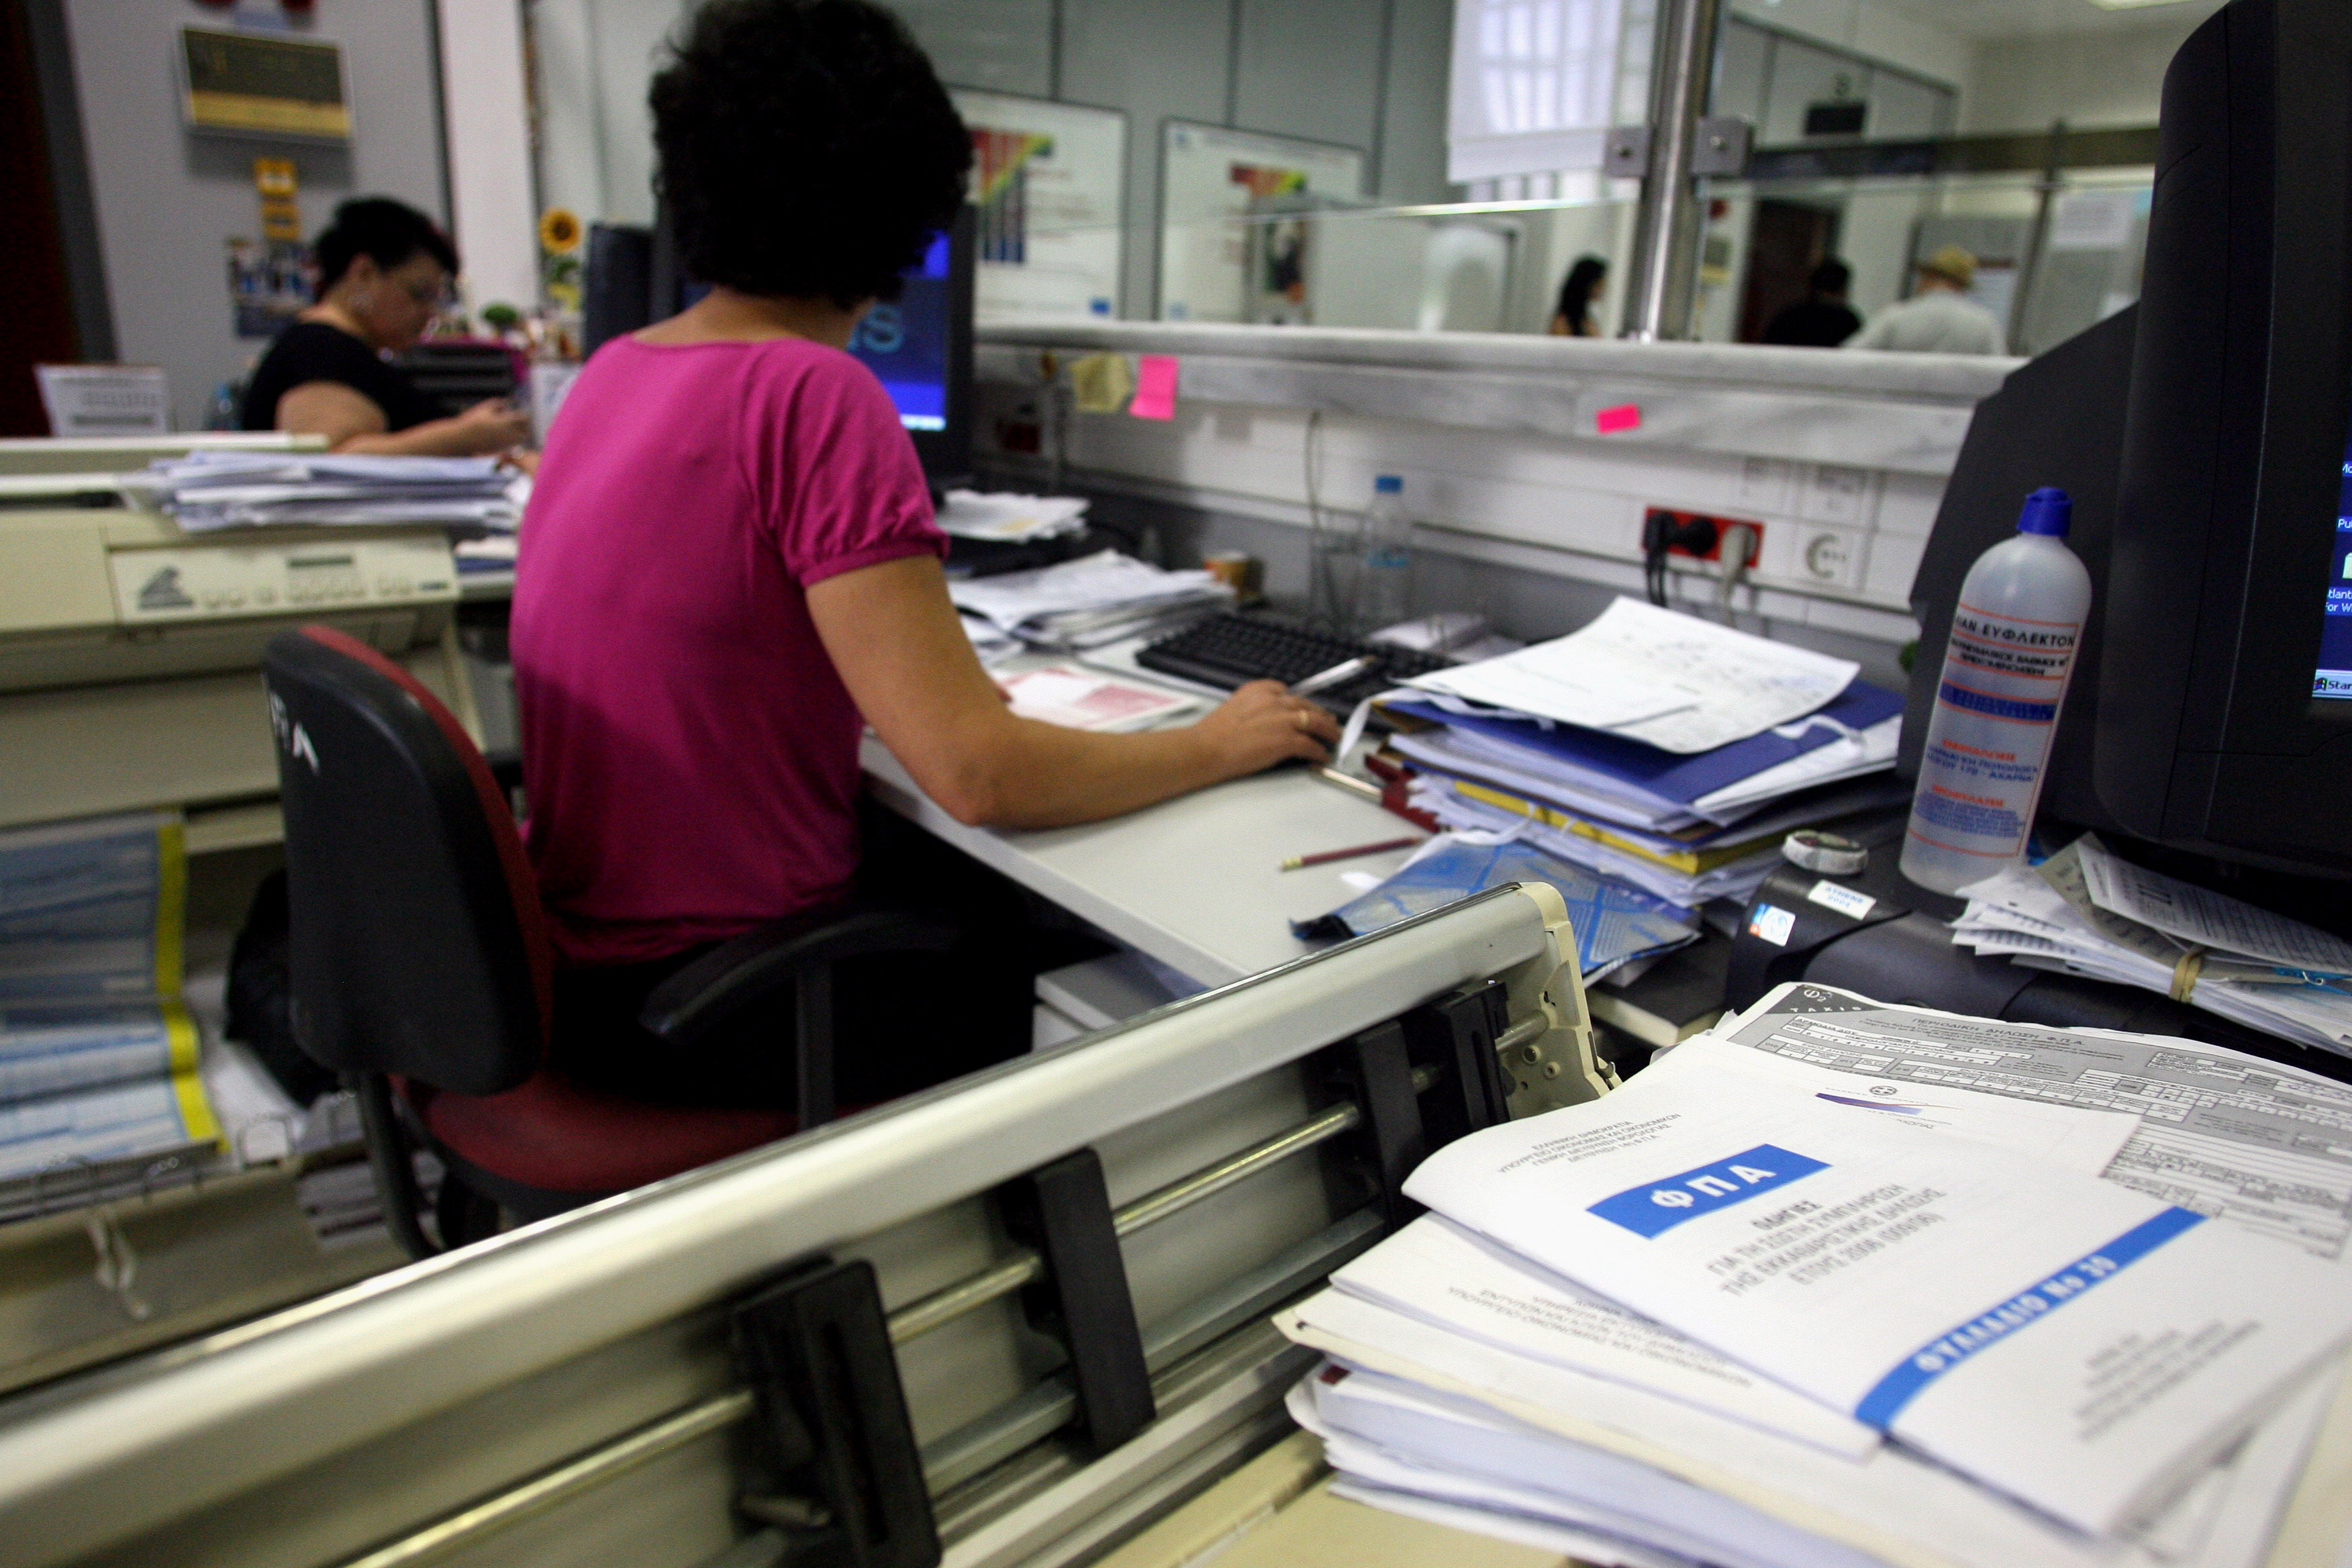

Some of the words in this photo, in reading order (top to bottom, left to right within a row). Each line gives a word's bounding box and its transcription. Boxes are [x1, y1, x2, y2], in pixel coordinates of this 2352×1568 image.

[1912, 1018, 1979, 1032] ΠΕΡΙΟΔΙΚΗ
[1985, 1028, 2039, 1040] ΔΗΛΩΣΗ
[1650, 1165, 1777, 1208] ΦΠΑ
